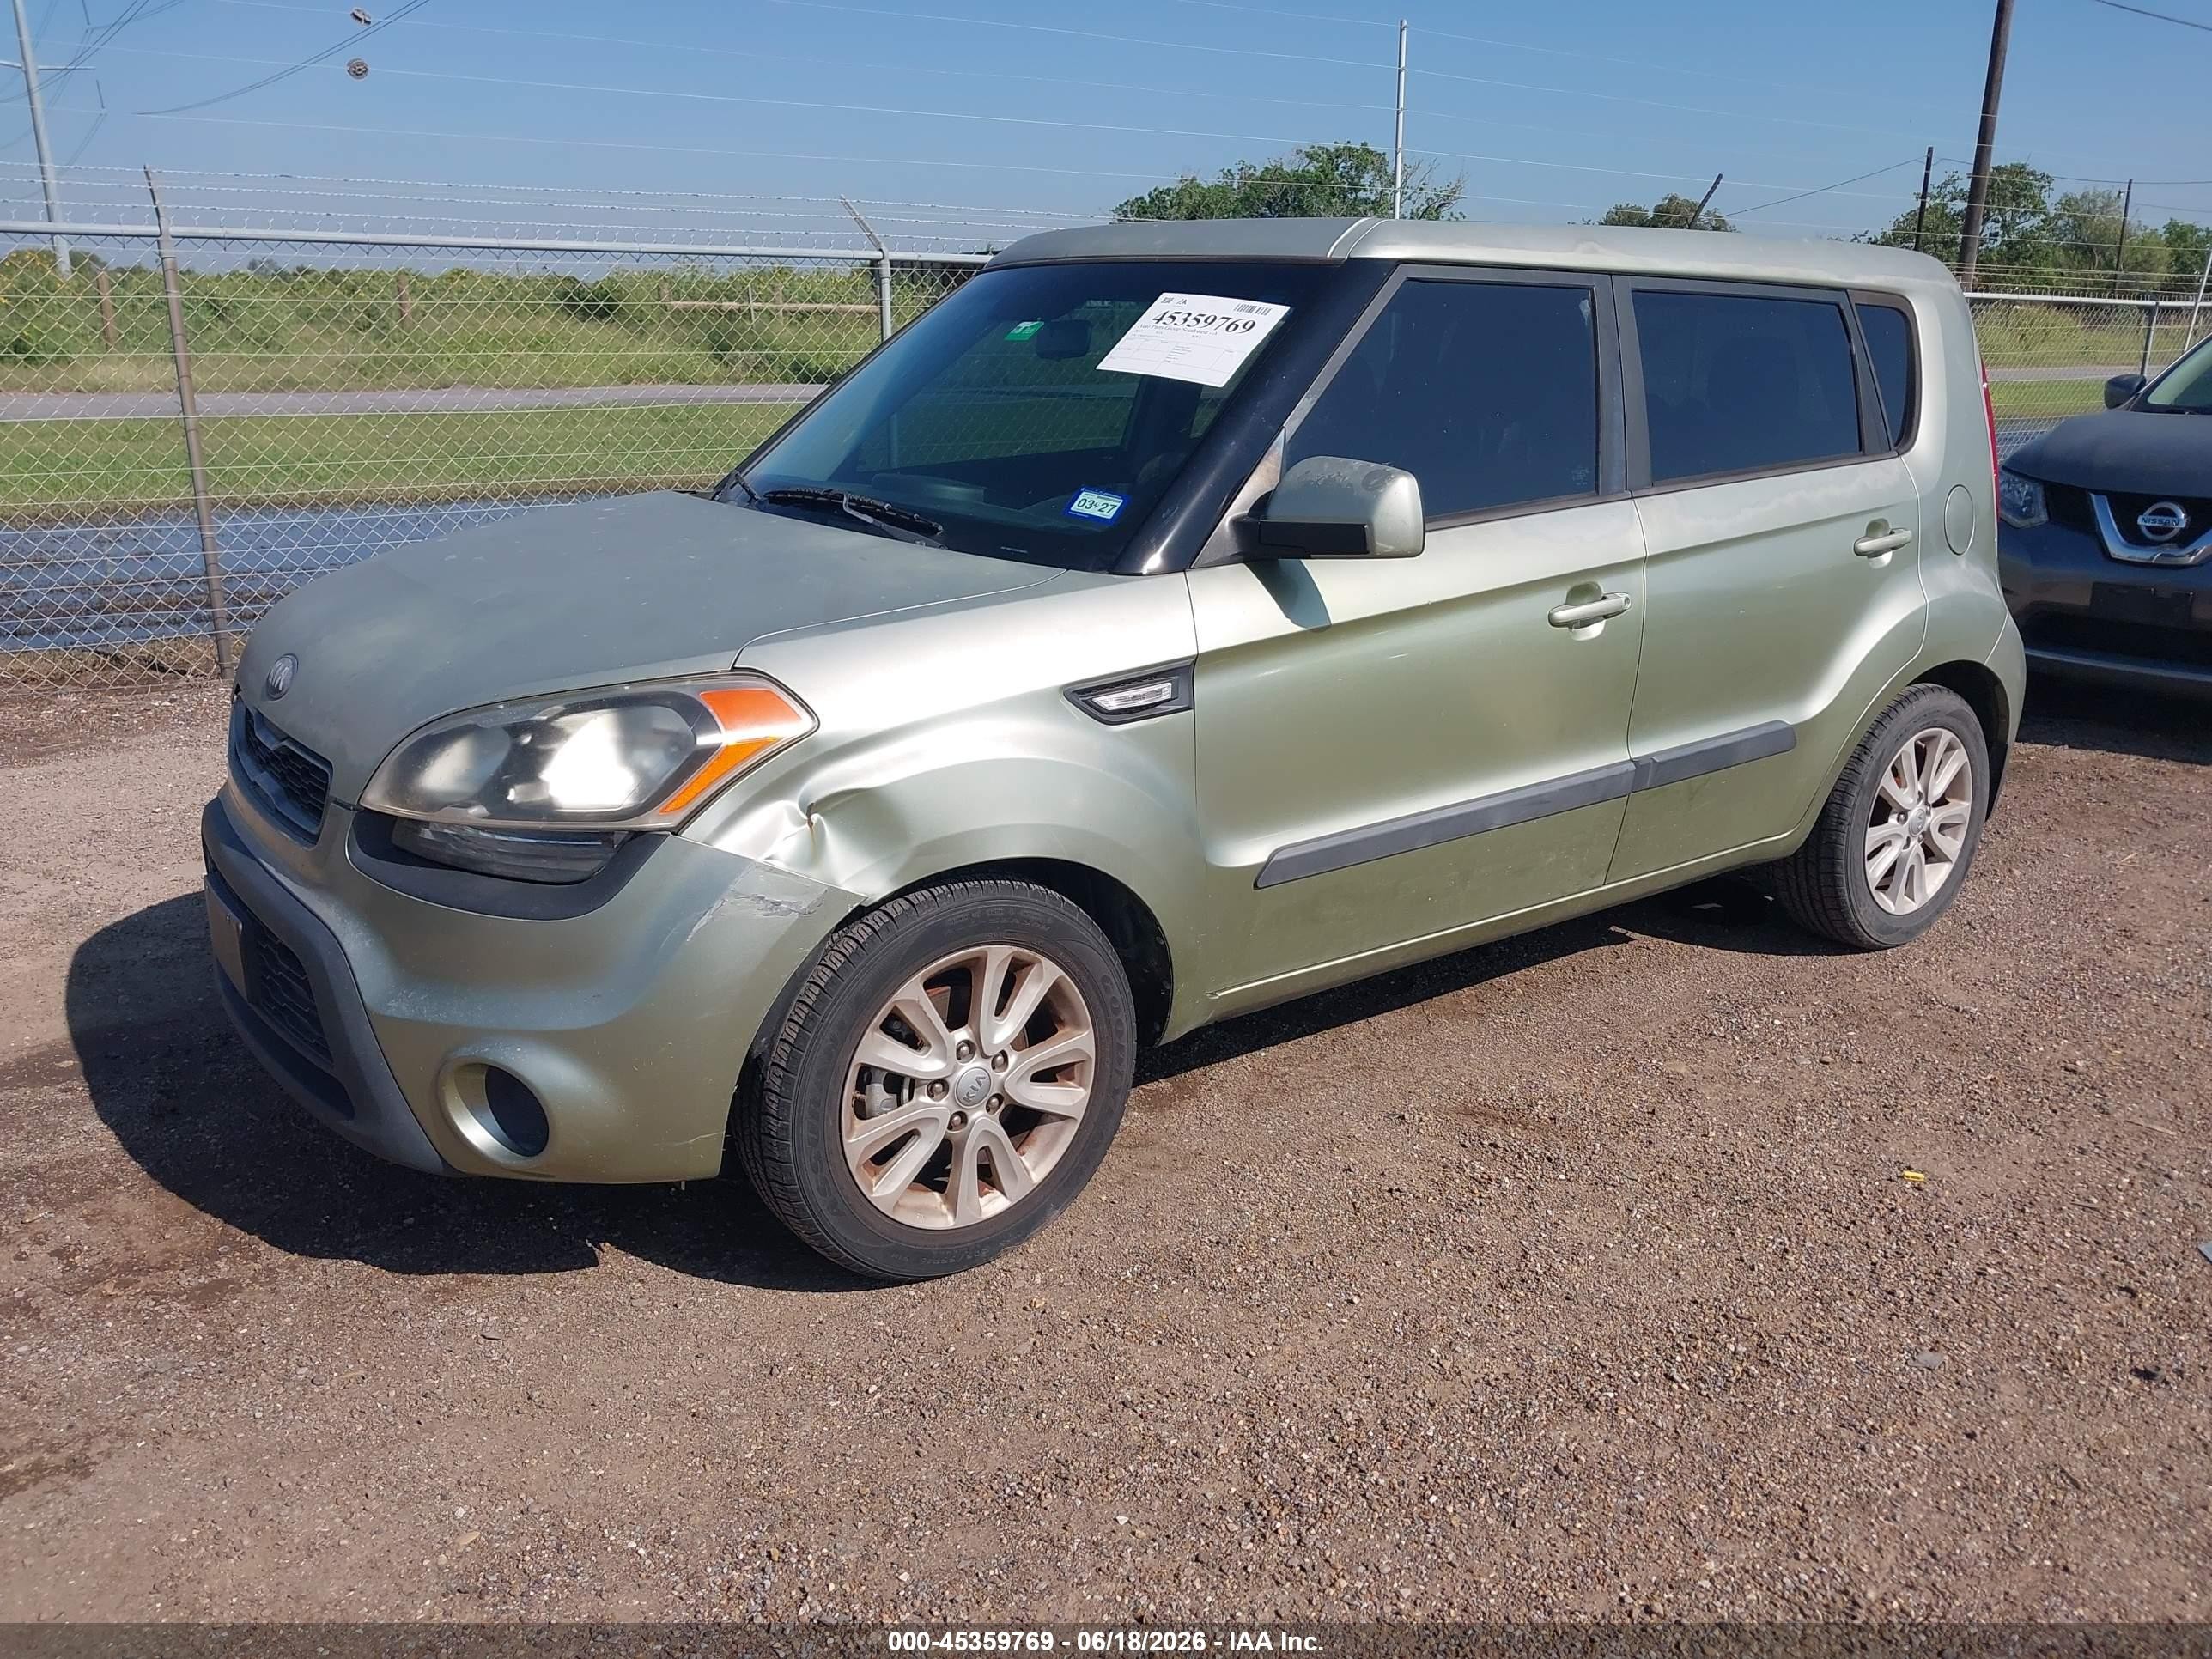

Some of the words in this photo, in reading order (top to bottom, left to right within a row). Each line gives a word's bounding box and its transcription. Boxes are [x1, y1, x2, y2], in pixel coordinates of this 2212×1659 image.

[1152, 310, 1255, 334] 45359769
[1097, 503, 1118, 514] 27
[2141, 517, 2179, 526] NISSAN
[963, 1076, 987, 1103] KIA
